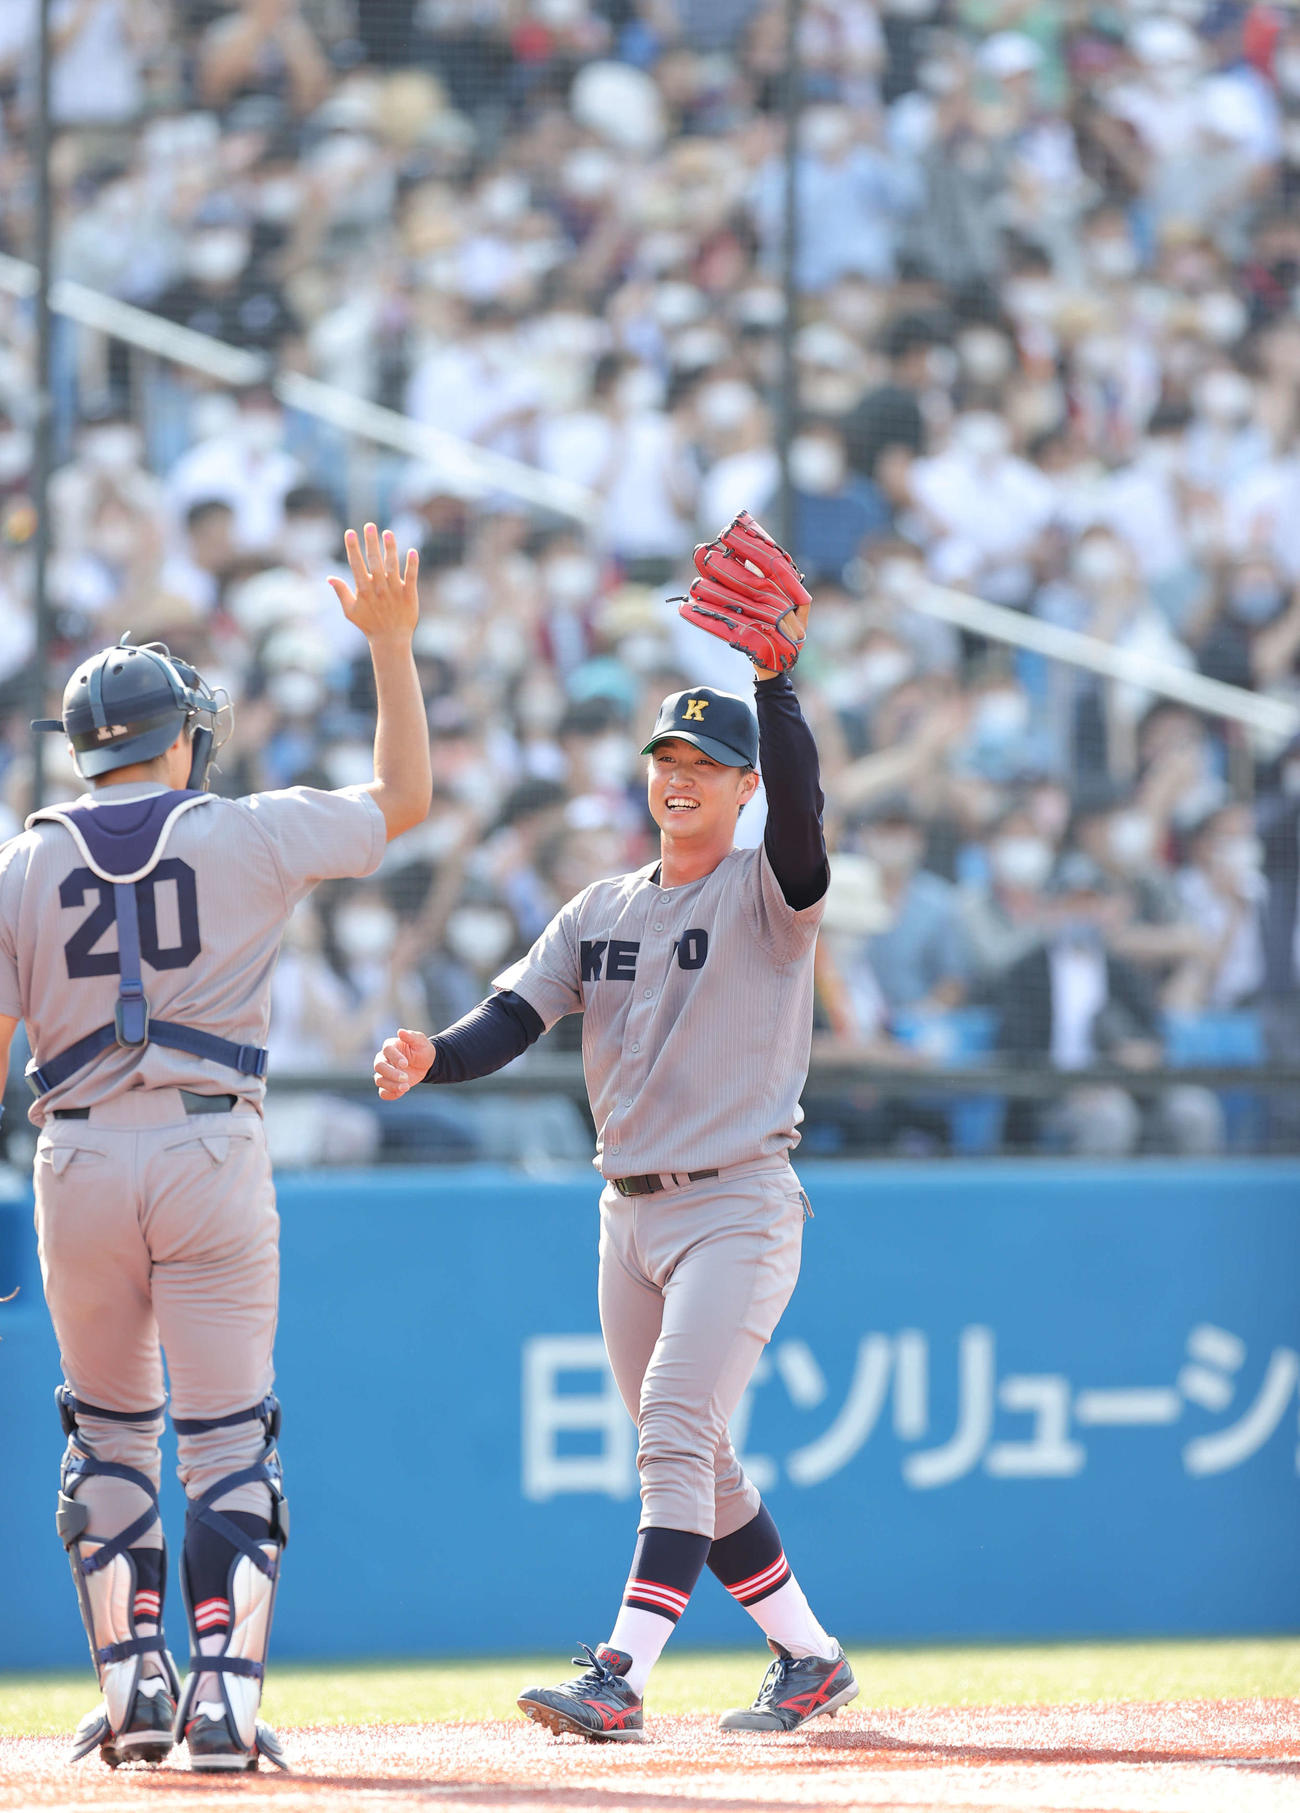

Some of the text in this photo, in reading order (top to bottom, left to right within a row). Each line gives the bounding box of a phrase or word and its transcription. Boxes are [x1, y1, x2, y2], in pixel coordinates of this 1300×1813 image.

[682, 699, 709, 721] K
[59, 857, 201, 979] 20
[580, 928, 708, 981] KEO
[521, 1324, 1300, 1499] 日ソリューシ
